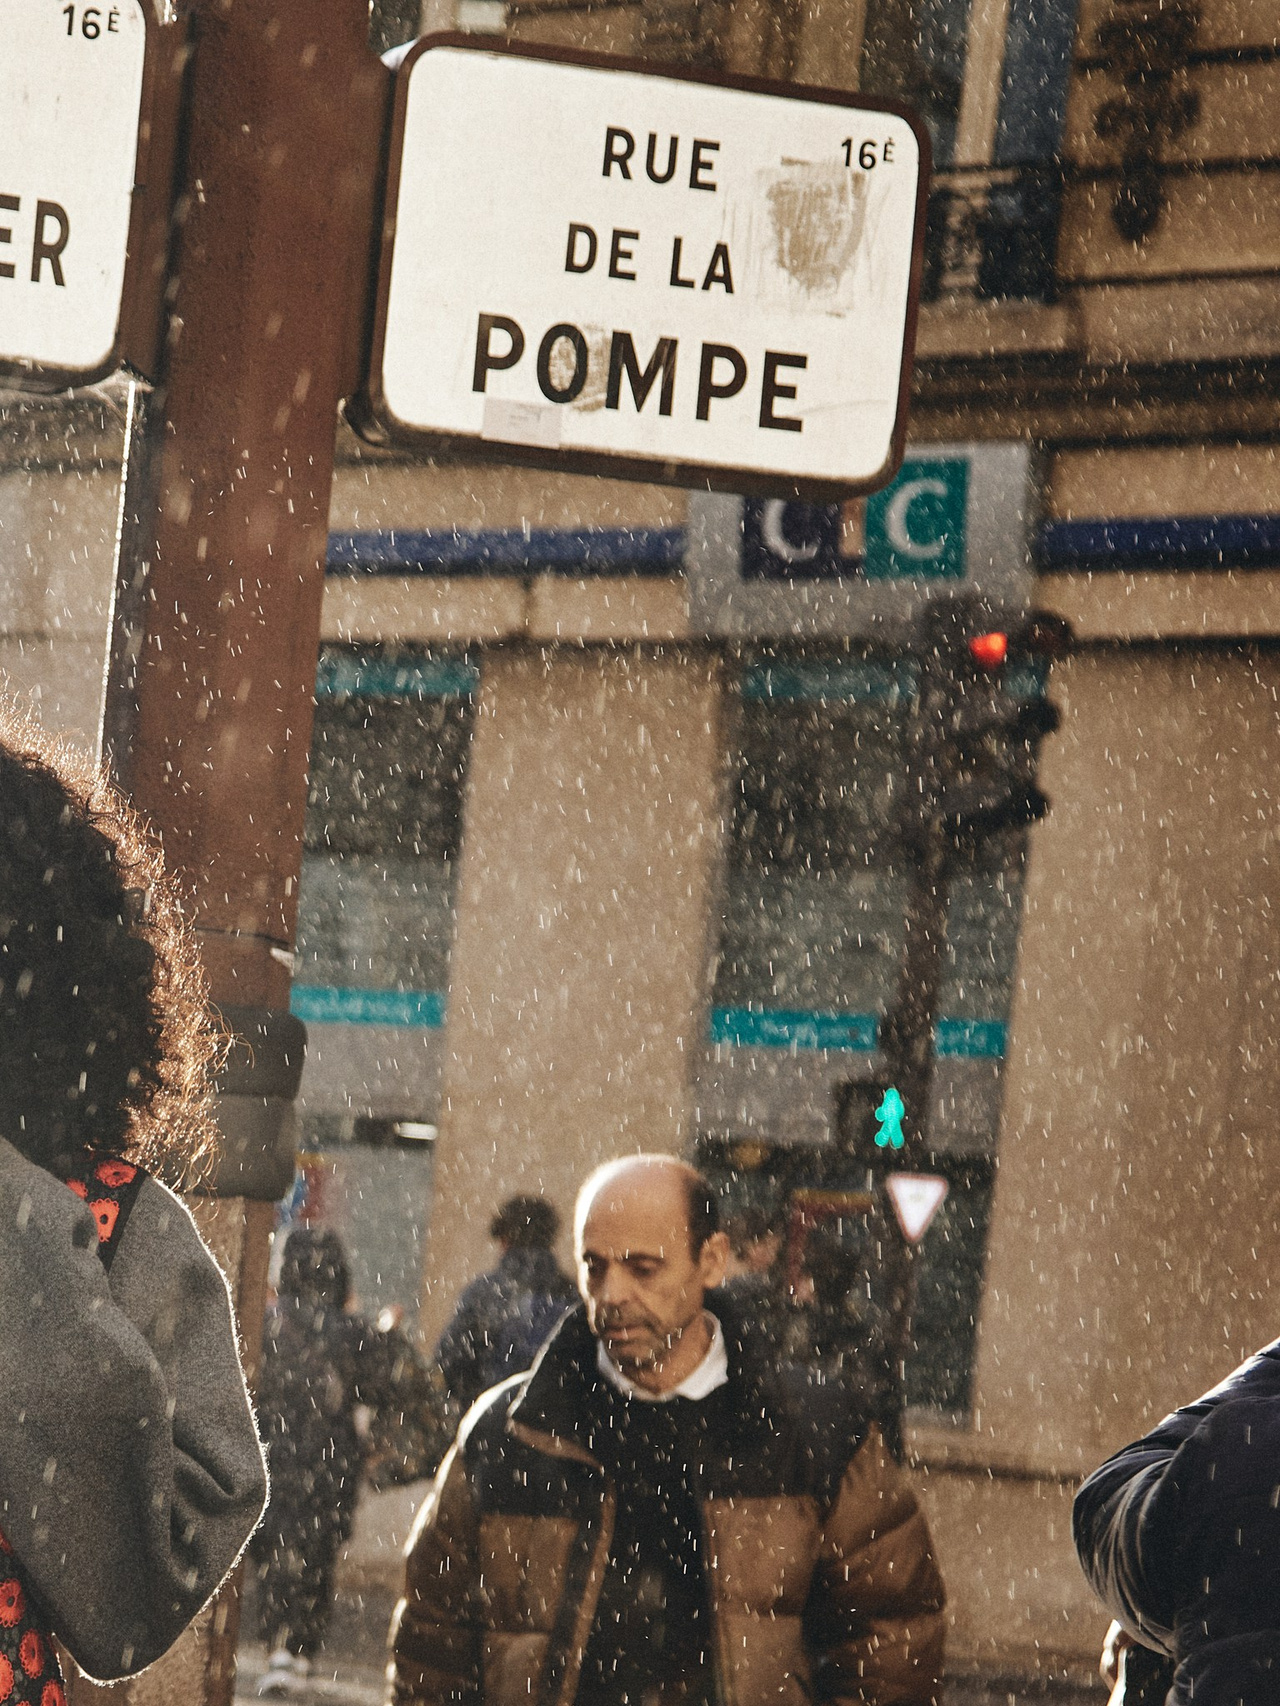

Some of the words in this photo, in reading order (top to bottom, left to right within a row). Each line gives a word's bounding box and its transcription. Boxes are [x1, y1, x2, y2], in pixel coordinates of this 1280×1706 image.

[601, 126, 721, 193] RUE
[564, 222, 640, 282] DE
[668, 236, 736, 294] LA
[471, 311, 808, 433] POMPE
